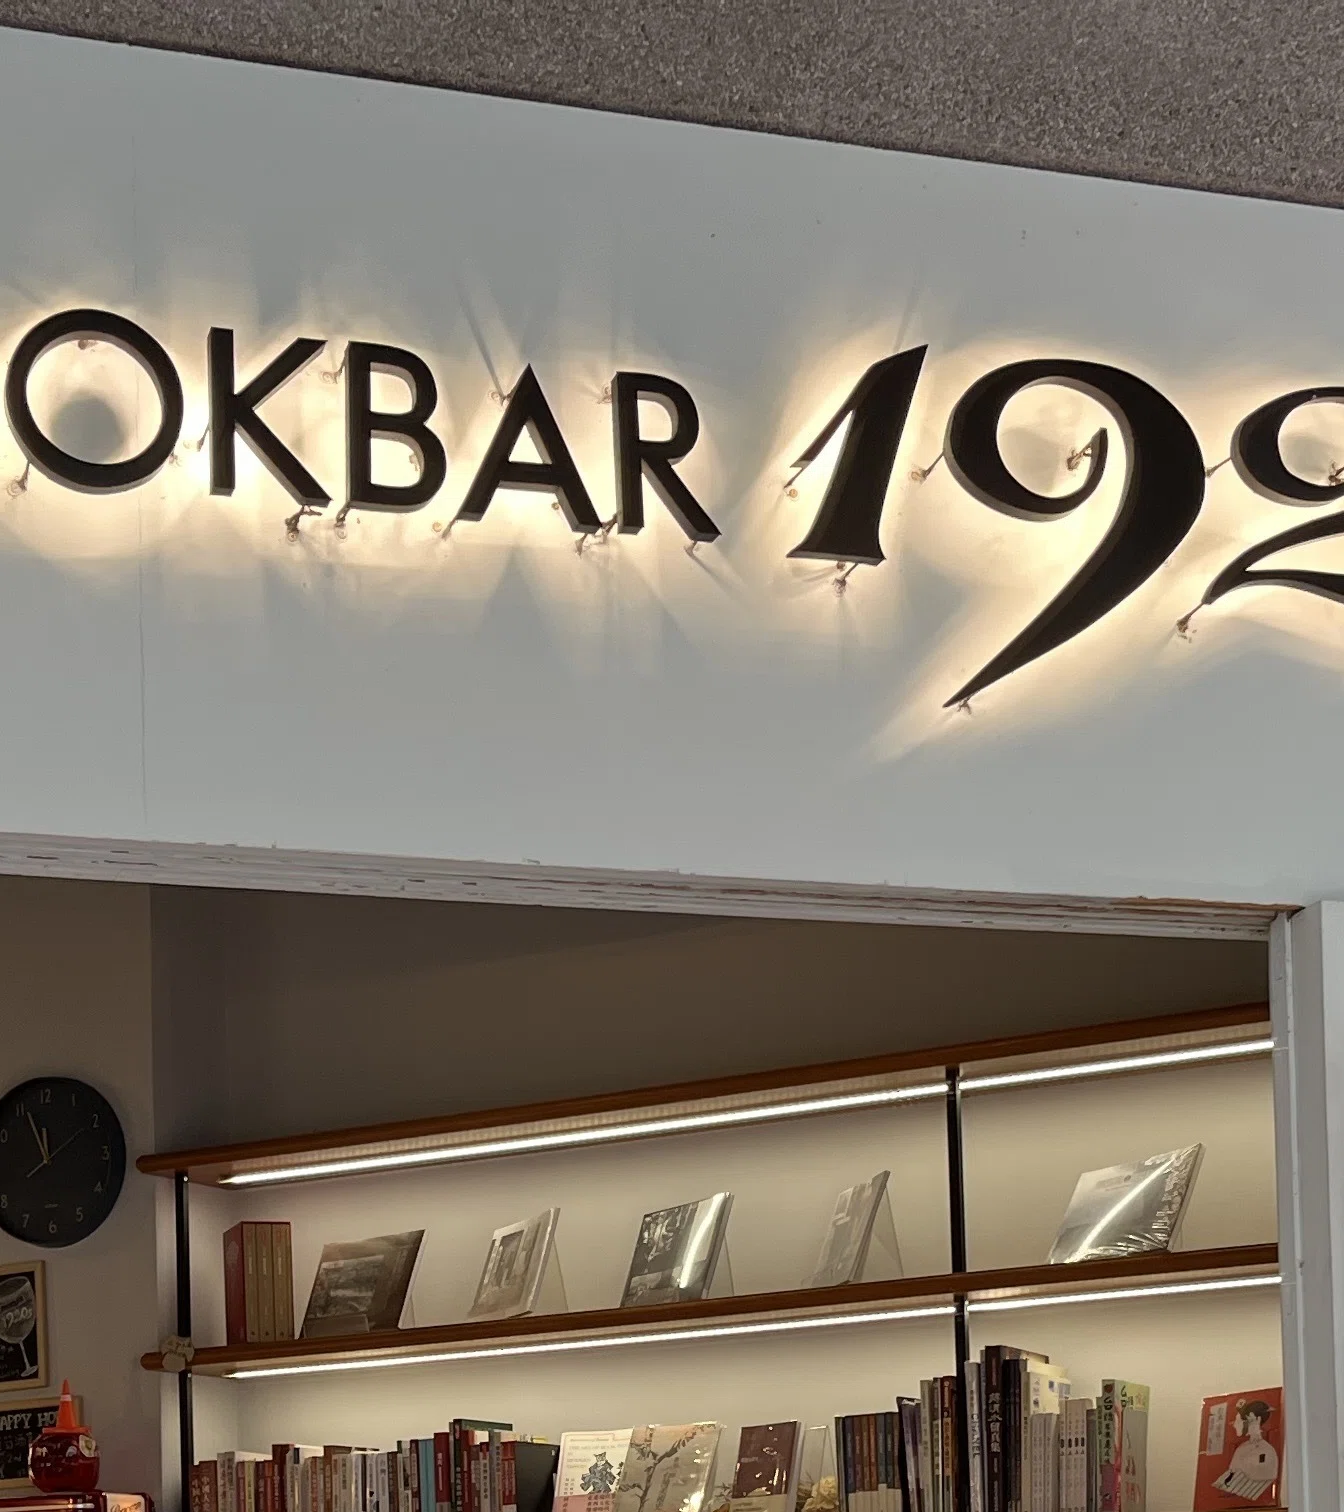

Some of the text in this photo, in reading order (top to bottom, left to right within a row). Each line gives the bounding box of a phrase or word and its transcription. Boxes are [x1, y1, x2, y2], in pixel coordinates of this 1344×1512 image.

[40, 1088, 51, 1105] 12
[92, 1113, 99, 1128] 2
[102, 1145, 110, 1161] 3
[94, 1181, 104, 1193] 4
[0, 1194, 8, 1209] 8
[22, 1213, 30, 1229] 7
[76, 1206, 84, 1222] 5
[48, 1220, 57, 1234] 6
[37, 1411, 59, 1428] HO
